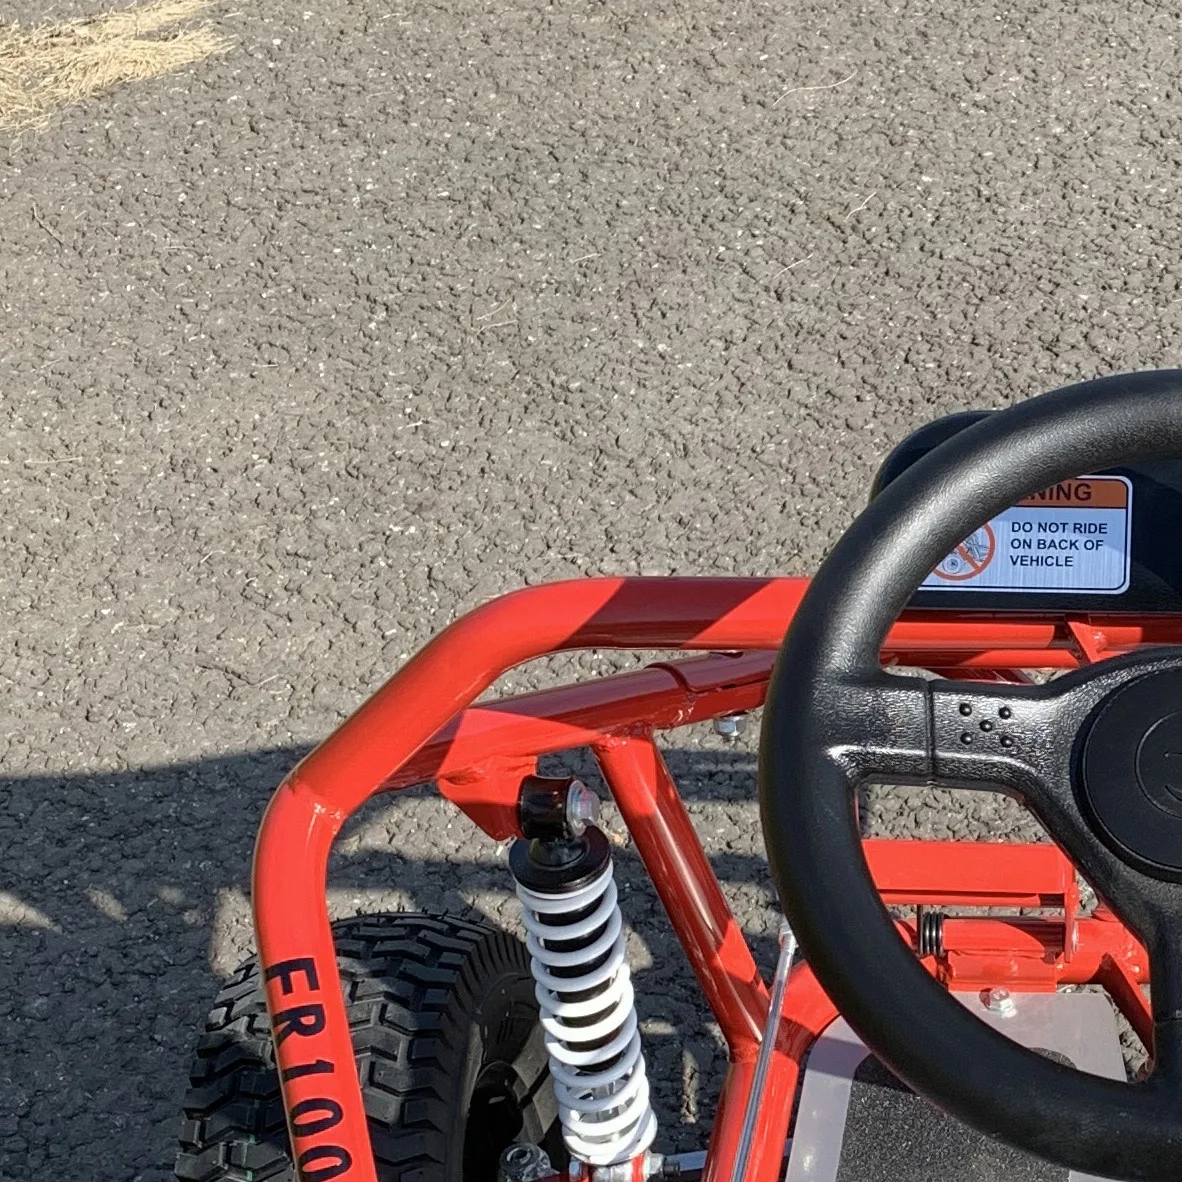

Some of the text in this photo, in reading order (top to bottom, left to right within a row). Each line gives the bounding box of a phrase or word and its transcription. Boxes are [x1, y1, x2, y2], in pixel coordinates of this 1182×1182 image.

[1011, 521, 1108, 534] DO NOT RIDE
[1010, 538, 1104, 551] ON BACK OF
[1010, 554, 1074, 567] VEHICLE
